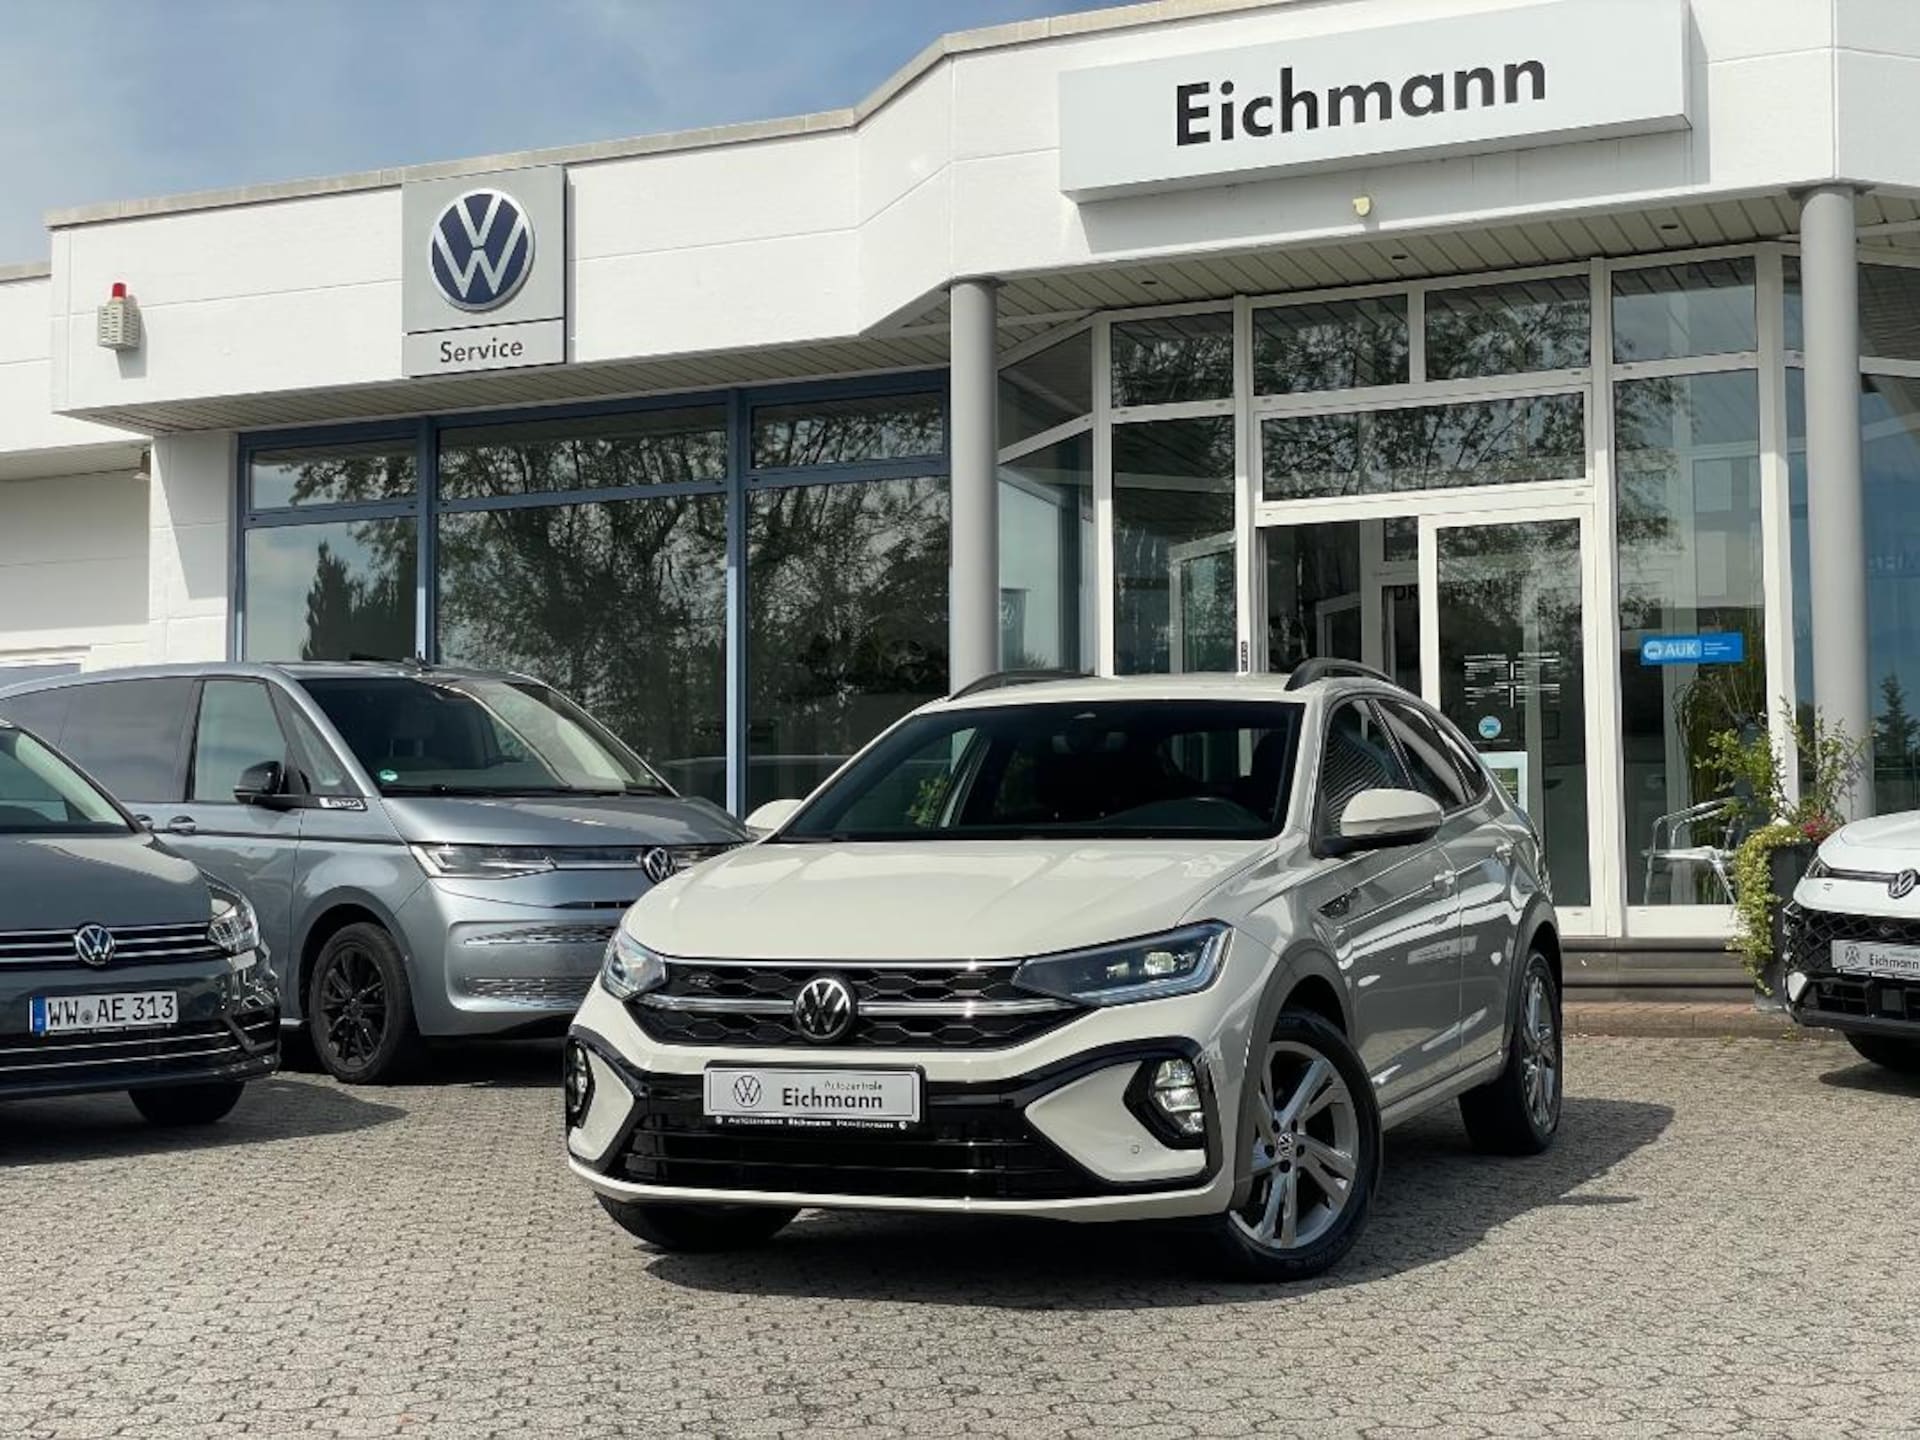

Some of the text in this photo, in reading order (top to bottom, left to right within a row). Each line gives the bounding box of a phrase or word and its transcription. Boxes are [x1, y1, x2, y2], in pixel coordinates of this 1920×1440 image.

[1176, 60, 1545, 146] Eichmann
[440, 338, 523, 363] Service
[1665, 642, 1697, 657] AUK
[1869, 953, 1919, 969] Eichmann
[49, 995, 174, 1025] WW AE 313
[782, 1086, 883, 1108] Eichmann
